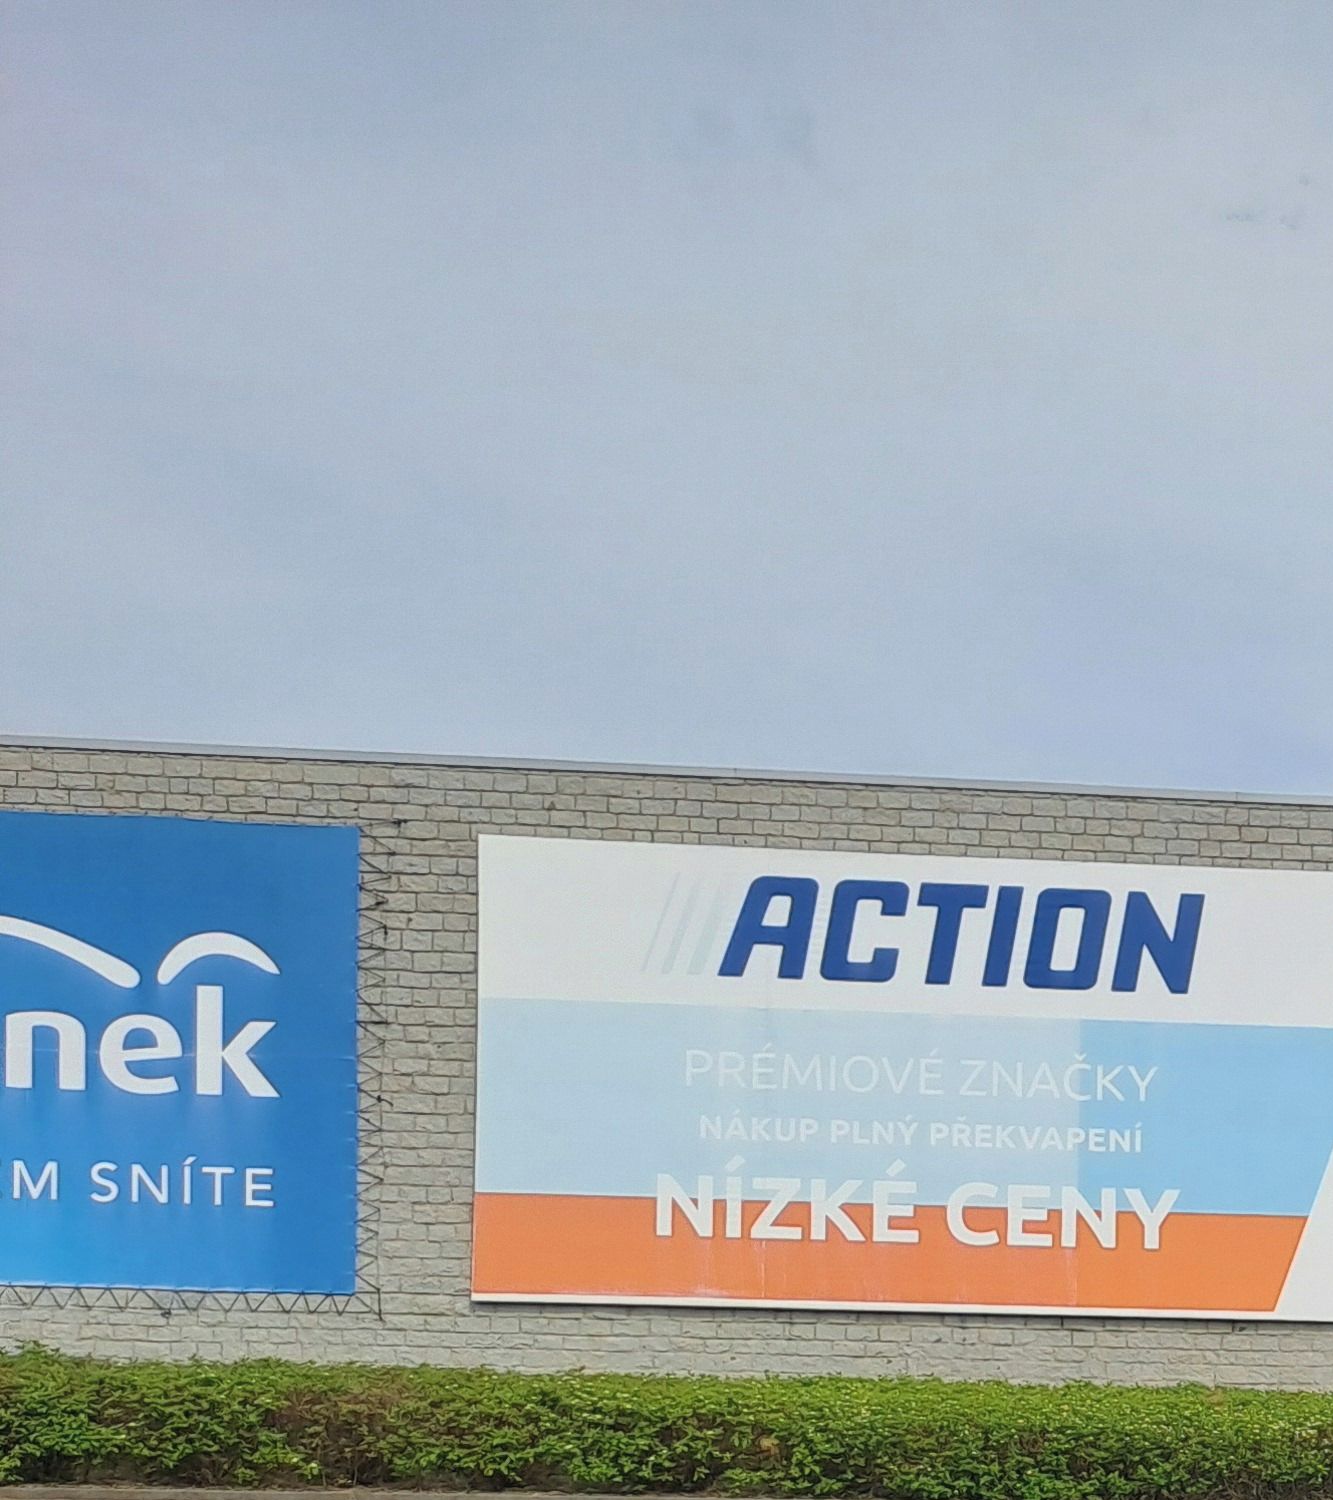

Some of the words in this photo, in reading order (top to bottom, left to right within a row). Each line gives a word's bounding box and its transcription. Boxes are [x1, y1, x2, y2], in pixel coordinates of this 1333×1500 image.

[718, 875, 1205, 994] ACTION
[685, 1043, 944, 1096] PRÉMIOVÉ
[959, 1053, 1159, 1102] ZNAČKY
[699, 1110, 819, 1143] NÁKUP
[830, 1114, 918, 1146] PLNÝ
[929, 1116, 1144, 1153] PŘEKVAPENÍ
[90, 1156, 275, 1208] SNÍTE
[655, 1155, 920, 1244] NÍZKÉ
[946, 1181, 1181, 1250] CENY
